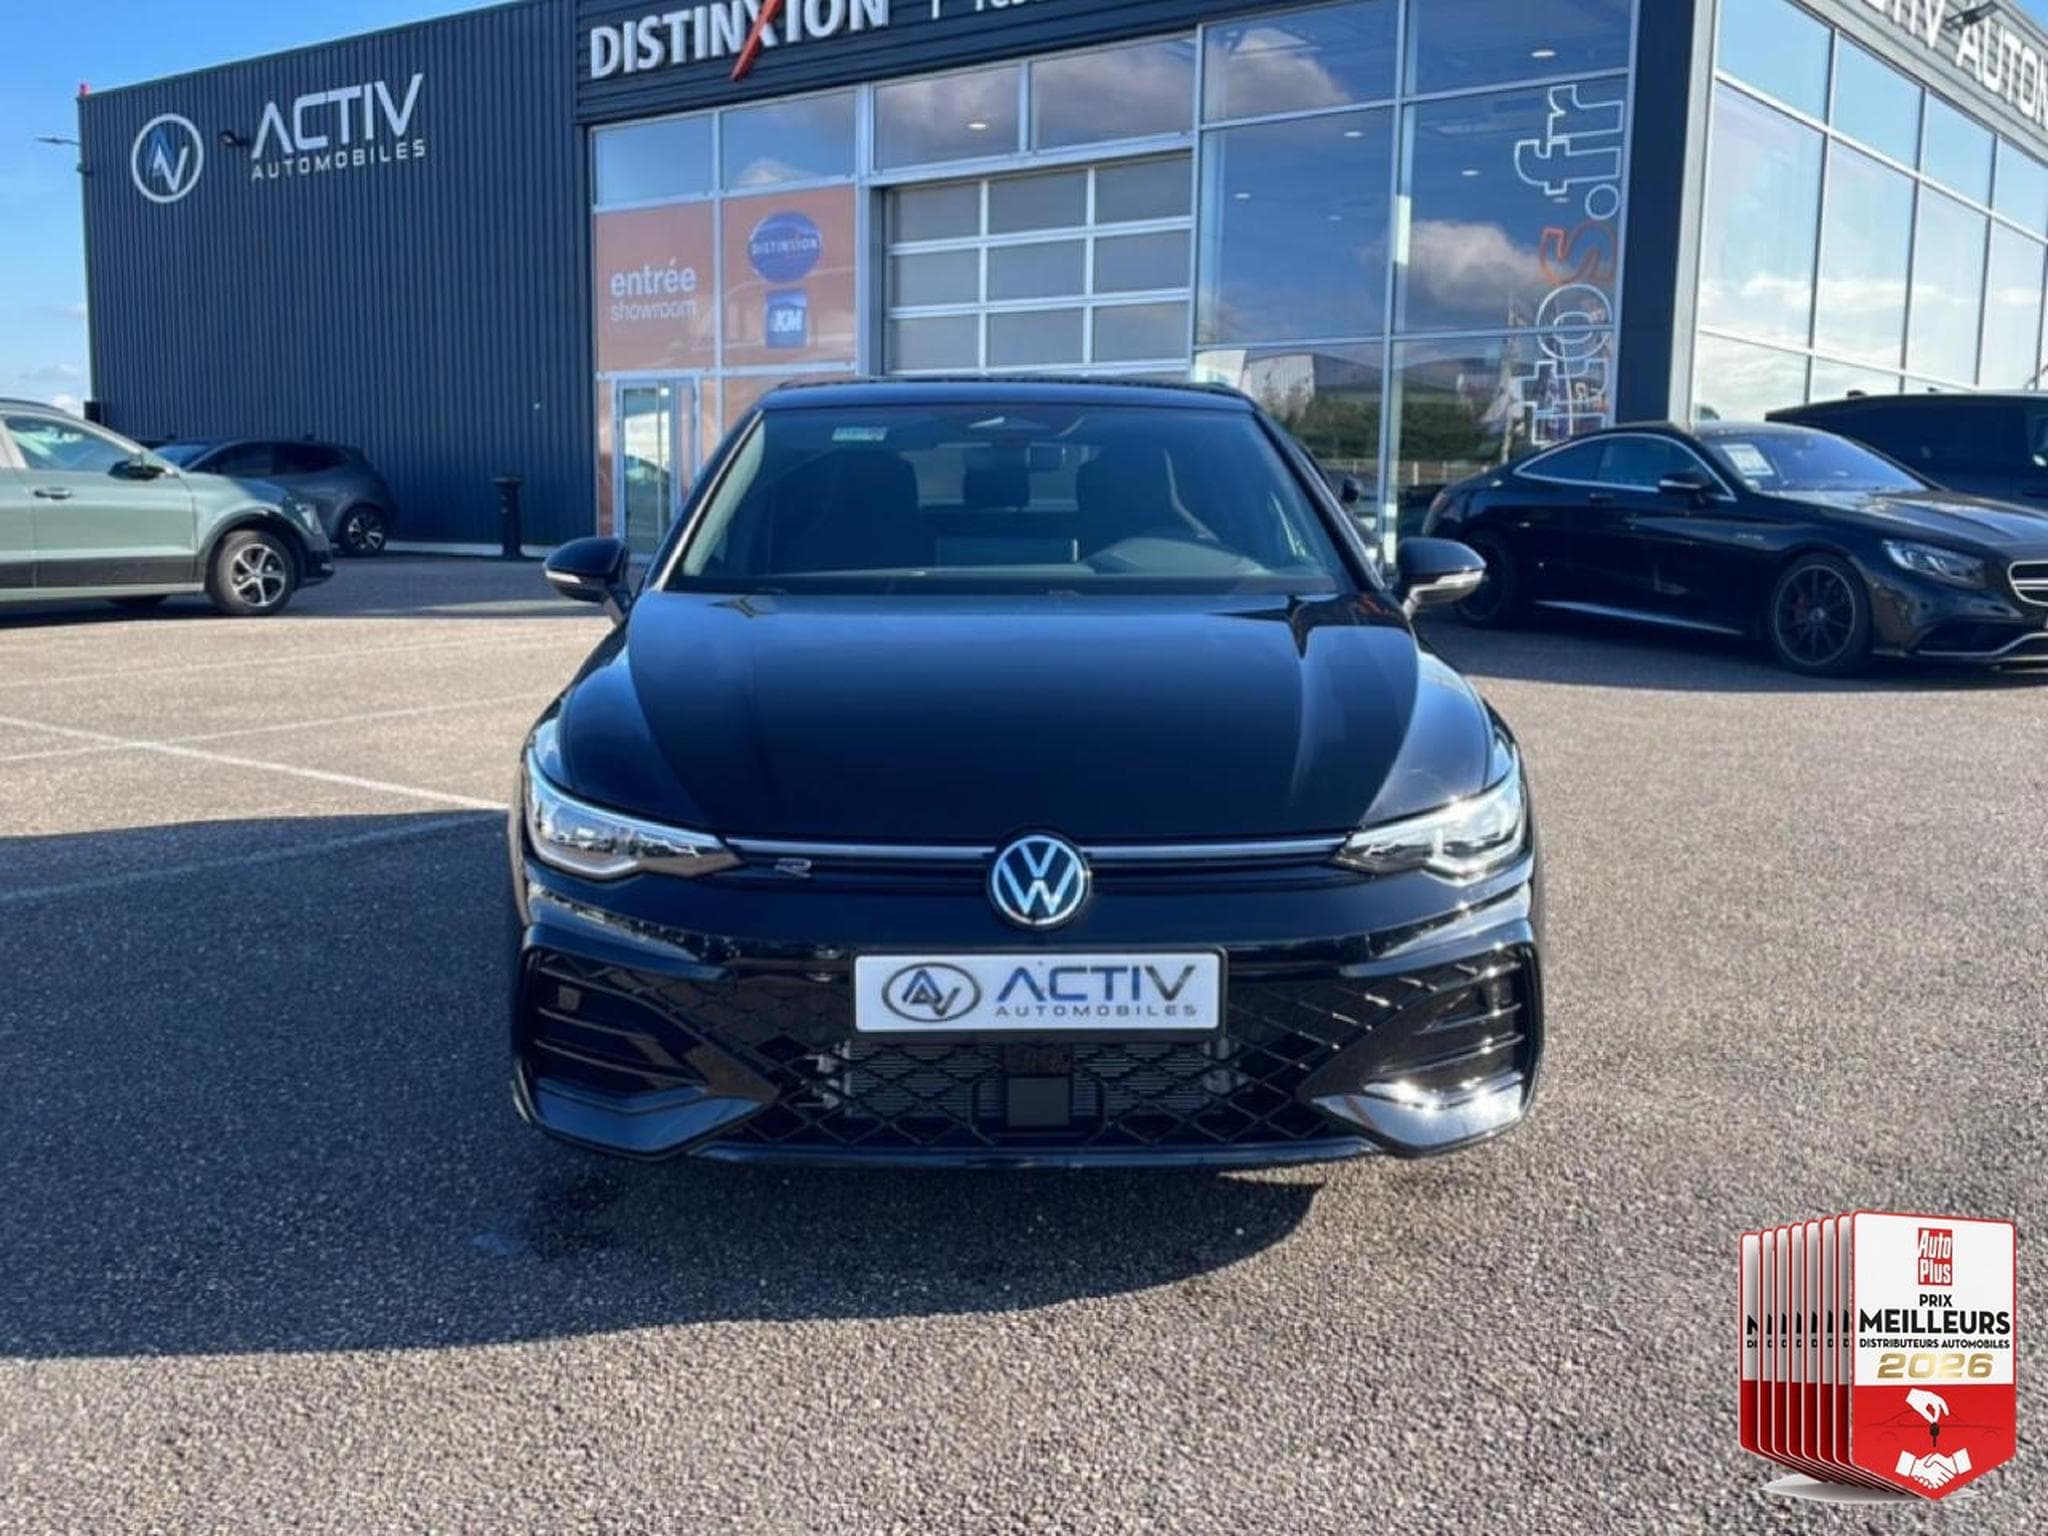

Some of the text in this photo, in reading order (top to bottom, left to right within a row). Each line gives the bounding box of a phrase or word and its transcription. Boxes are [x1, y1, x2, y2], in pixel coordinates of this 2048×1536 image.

[590, 0, 890, 80] DISTINXION
[251, 73, 423, 159] ACTIV
[250, 138, 426, 181] AUTOMOBILES
[611, 256, 697, 297] entrée
[611, 299, 698, 321] showroom
[995, 965, 1195, 1003] ACTIV
[994, 1003, 1197, 1018] AUTOMOBILES
